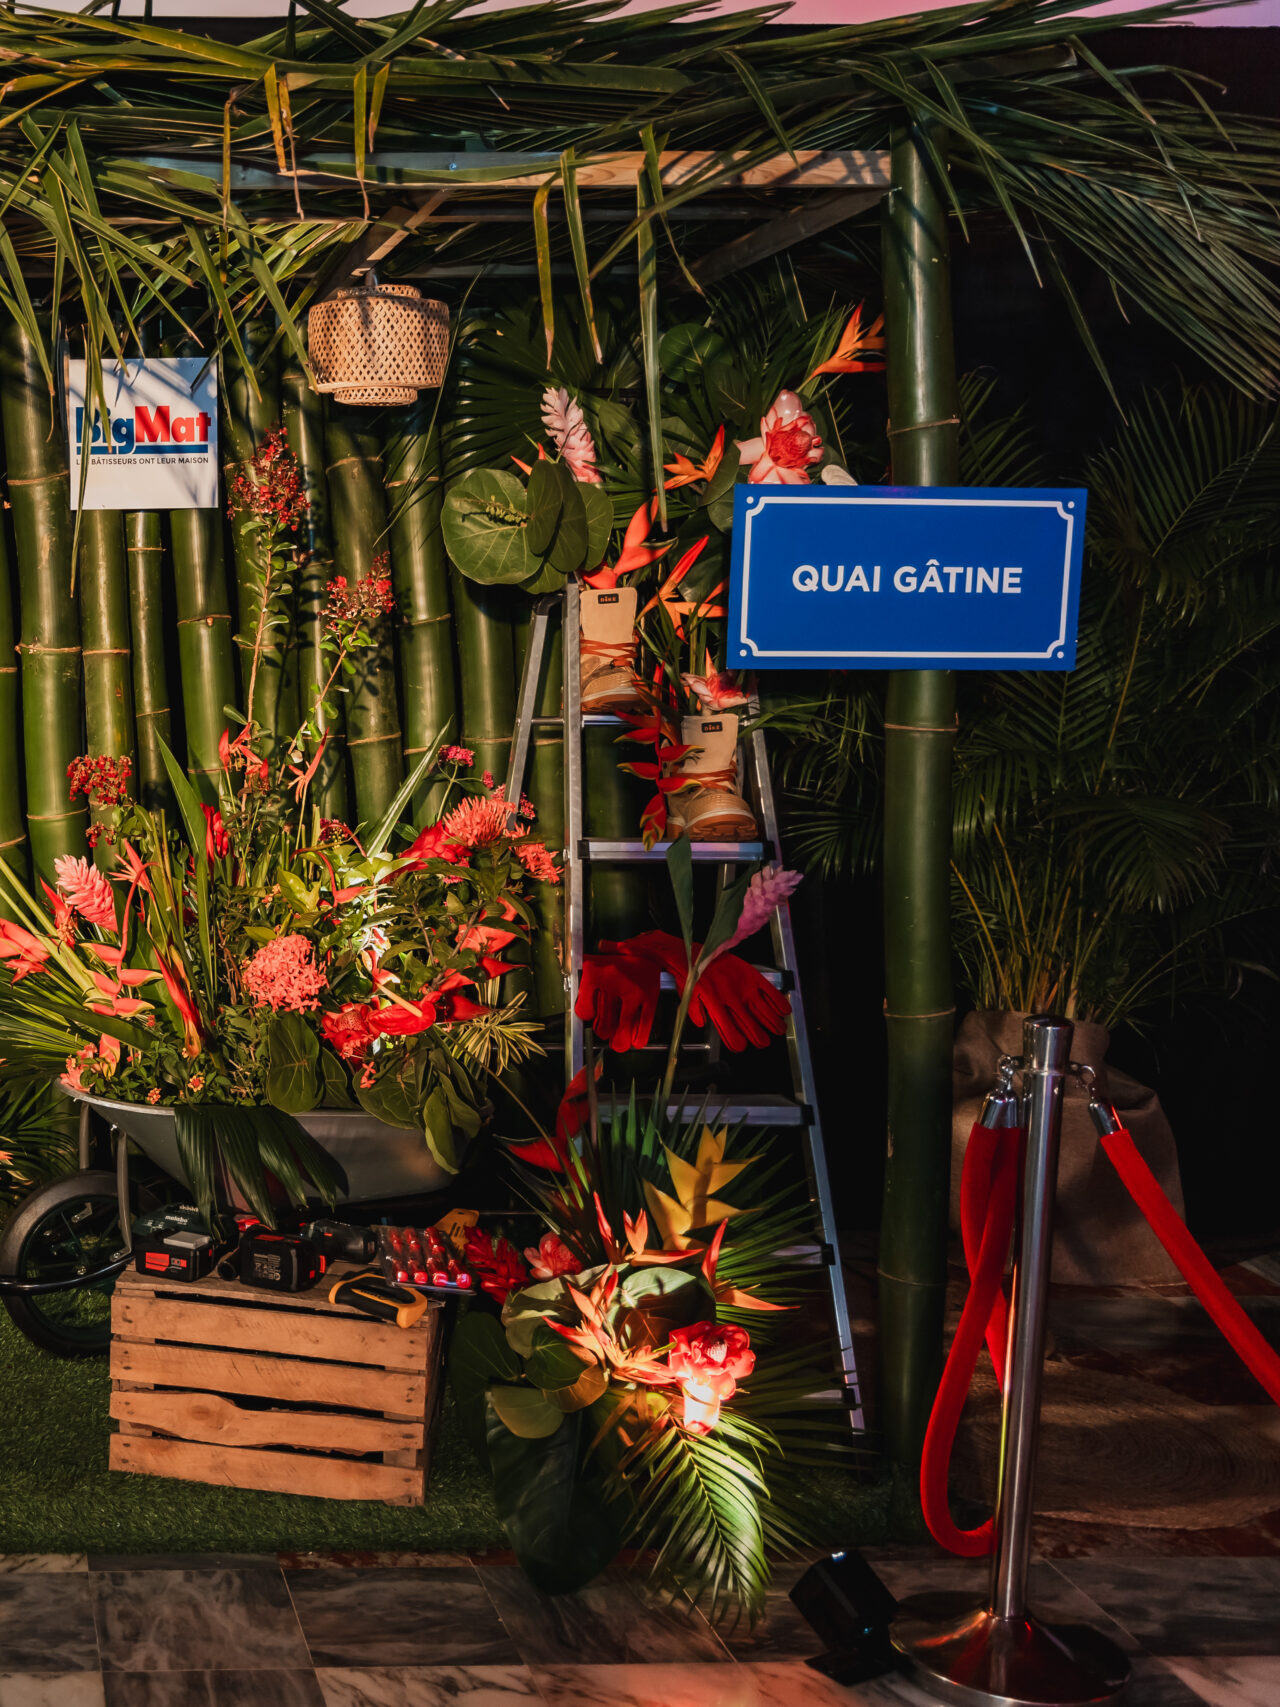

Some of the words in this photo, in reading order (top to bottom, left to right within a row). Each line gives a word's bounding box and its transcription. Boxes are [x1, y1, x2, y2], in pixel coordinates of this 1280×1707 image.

[91, 456, 137, 465] BÂTISSEURS
[138, 457, 156, 465] ONT
[156, 457, 177, 465] LEUR
[792, 564, 881, 593] QUAI
[893, 558, 1023, 594] GÂTINE
